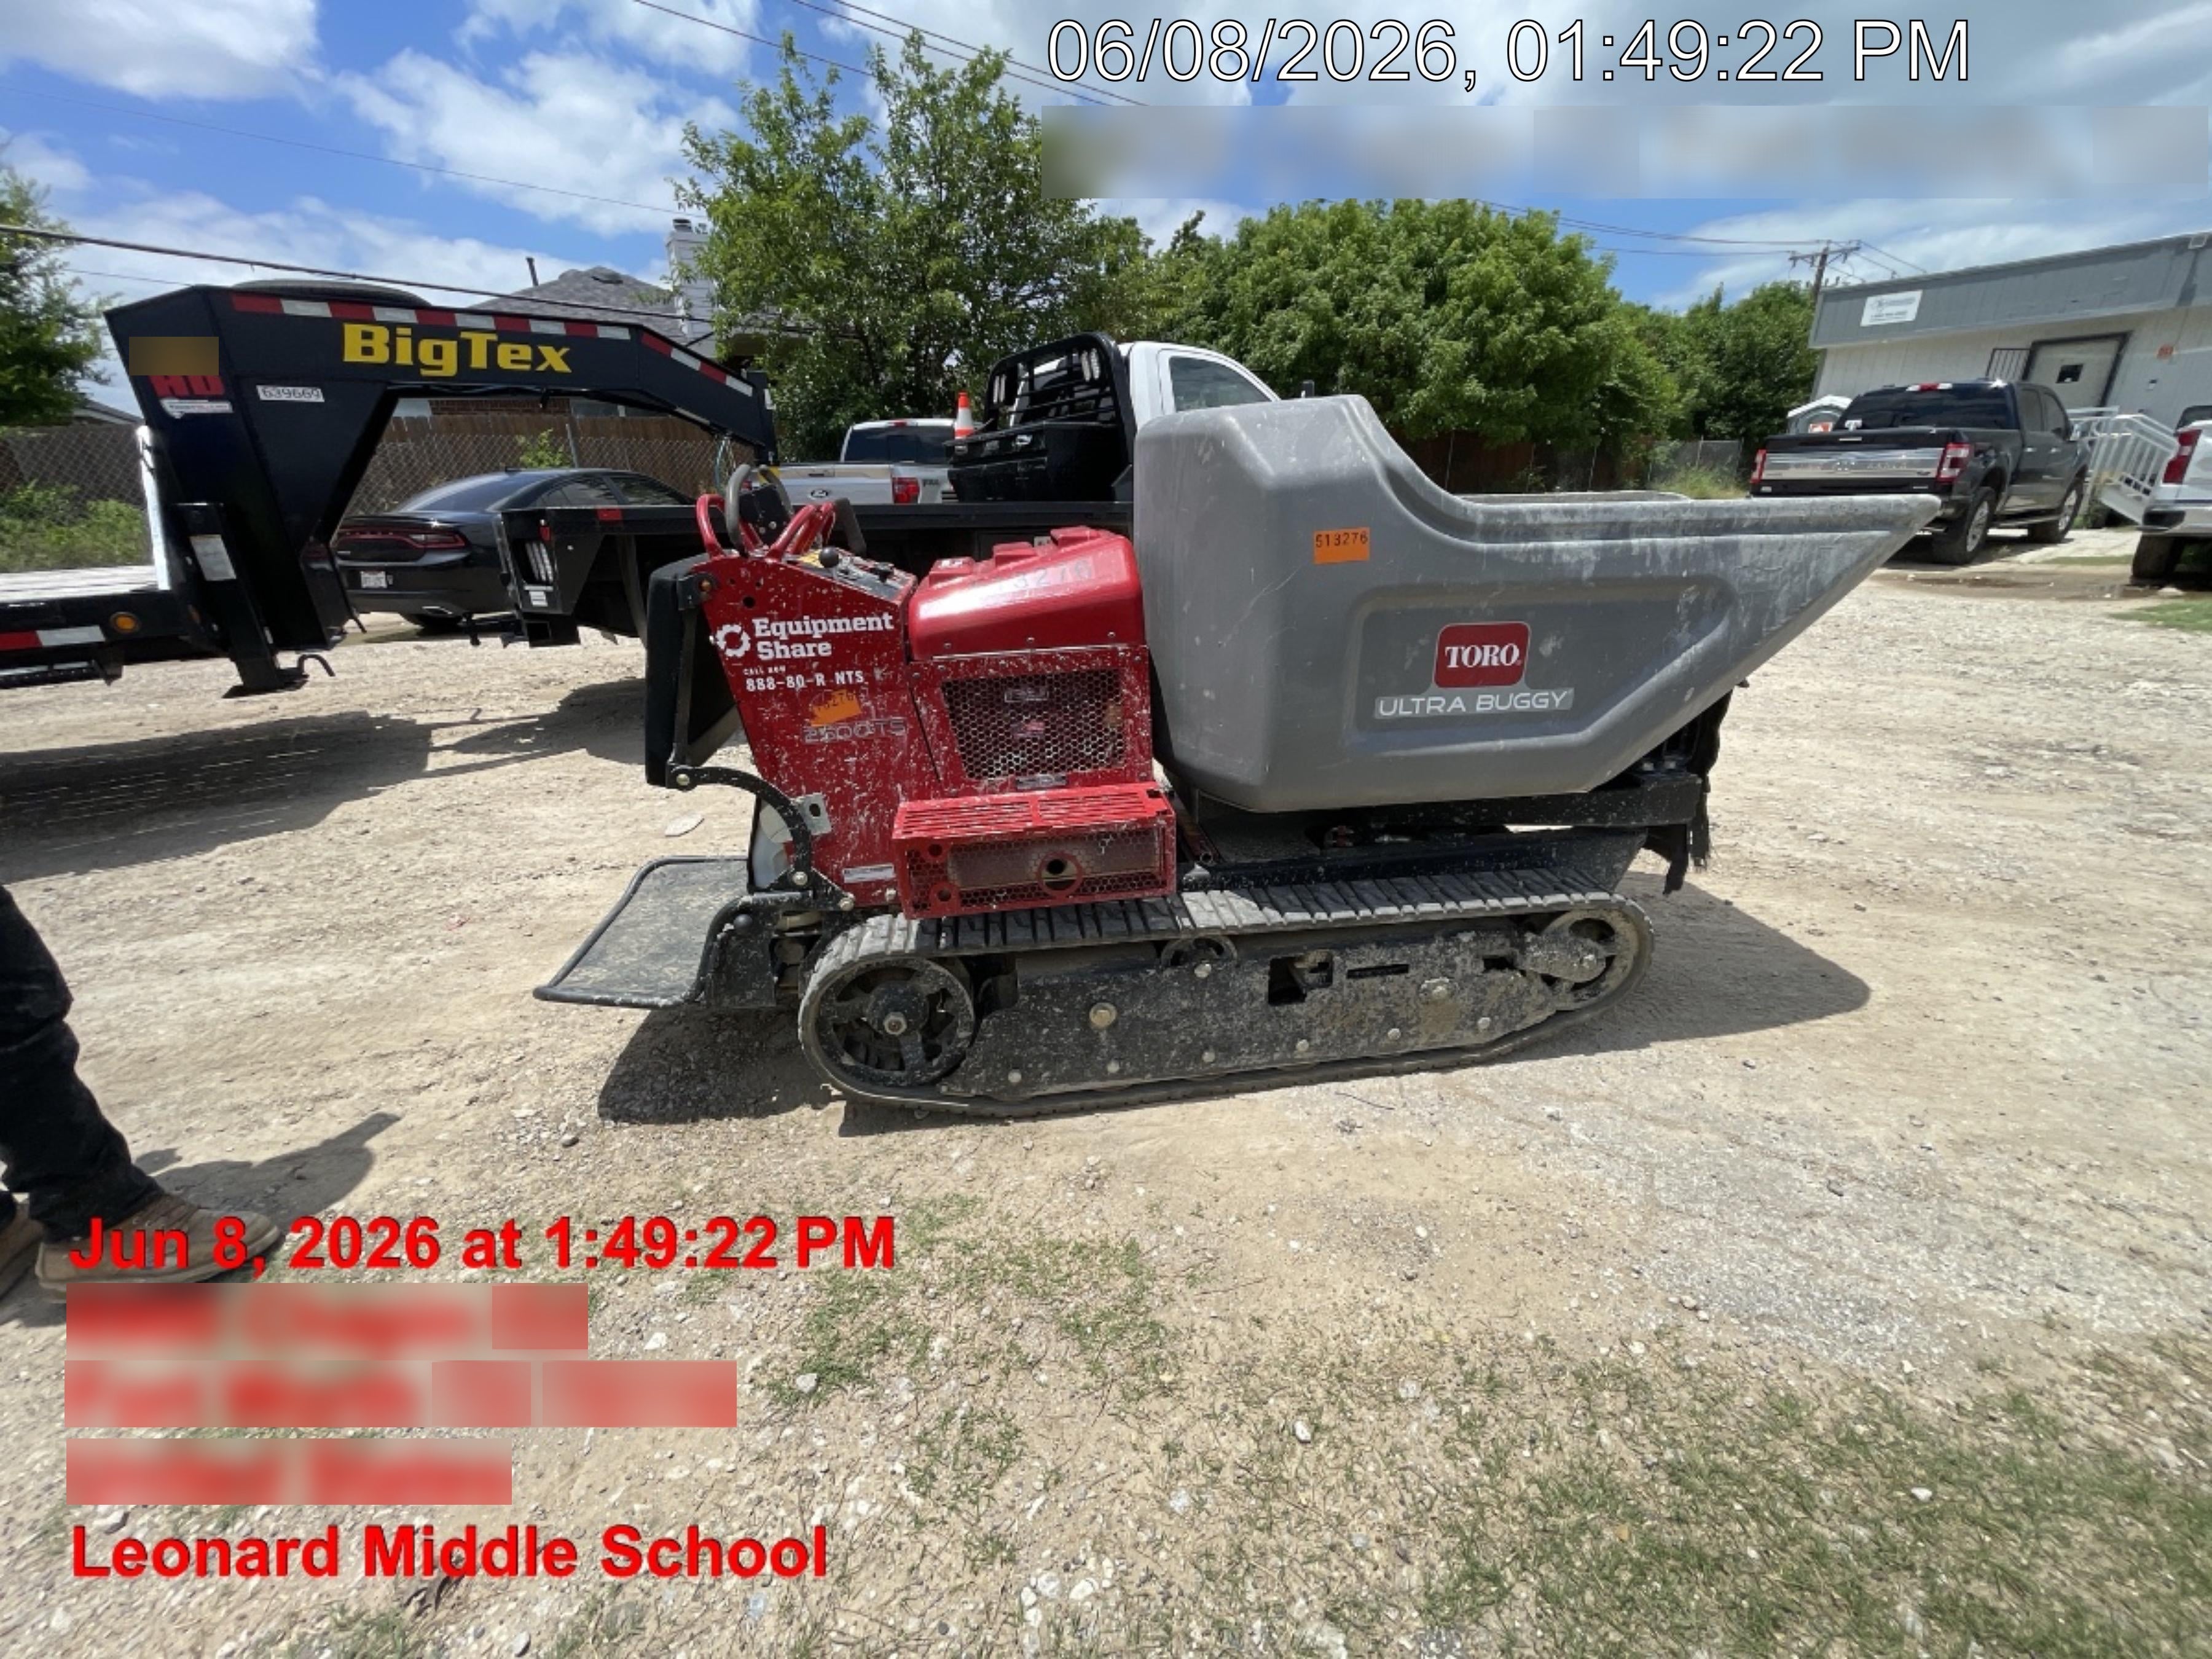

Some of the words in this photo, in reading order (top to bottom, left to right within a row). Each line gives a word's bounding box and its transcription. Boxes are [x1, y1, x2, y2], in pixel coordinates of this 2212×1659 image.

[342, 322, 572, 377] BigTex
[1316, 530, 1368, 548] 513276
[752, 611, 895, 640] Equipment
[756, 640, 833, 661] Share
[1445, 643, 1520, 669] TORO
[1379, 696, 1466, 716] ULTRA
[1476, 691, 1567, 712] BUGGY
